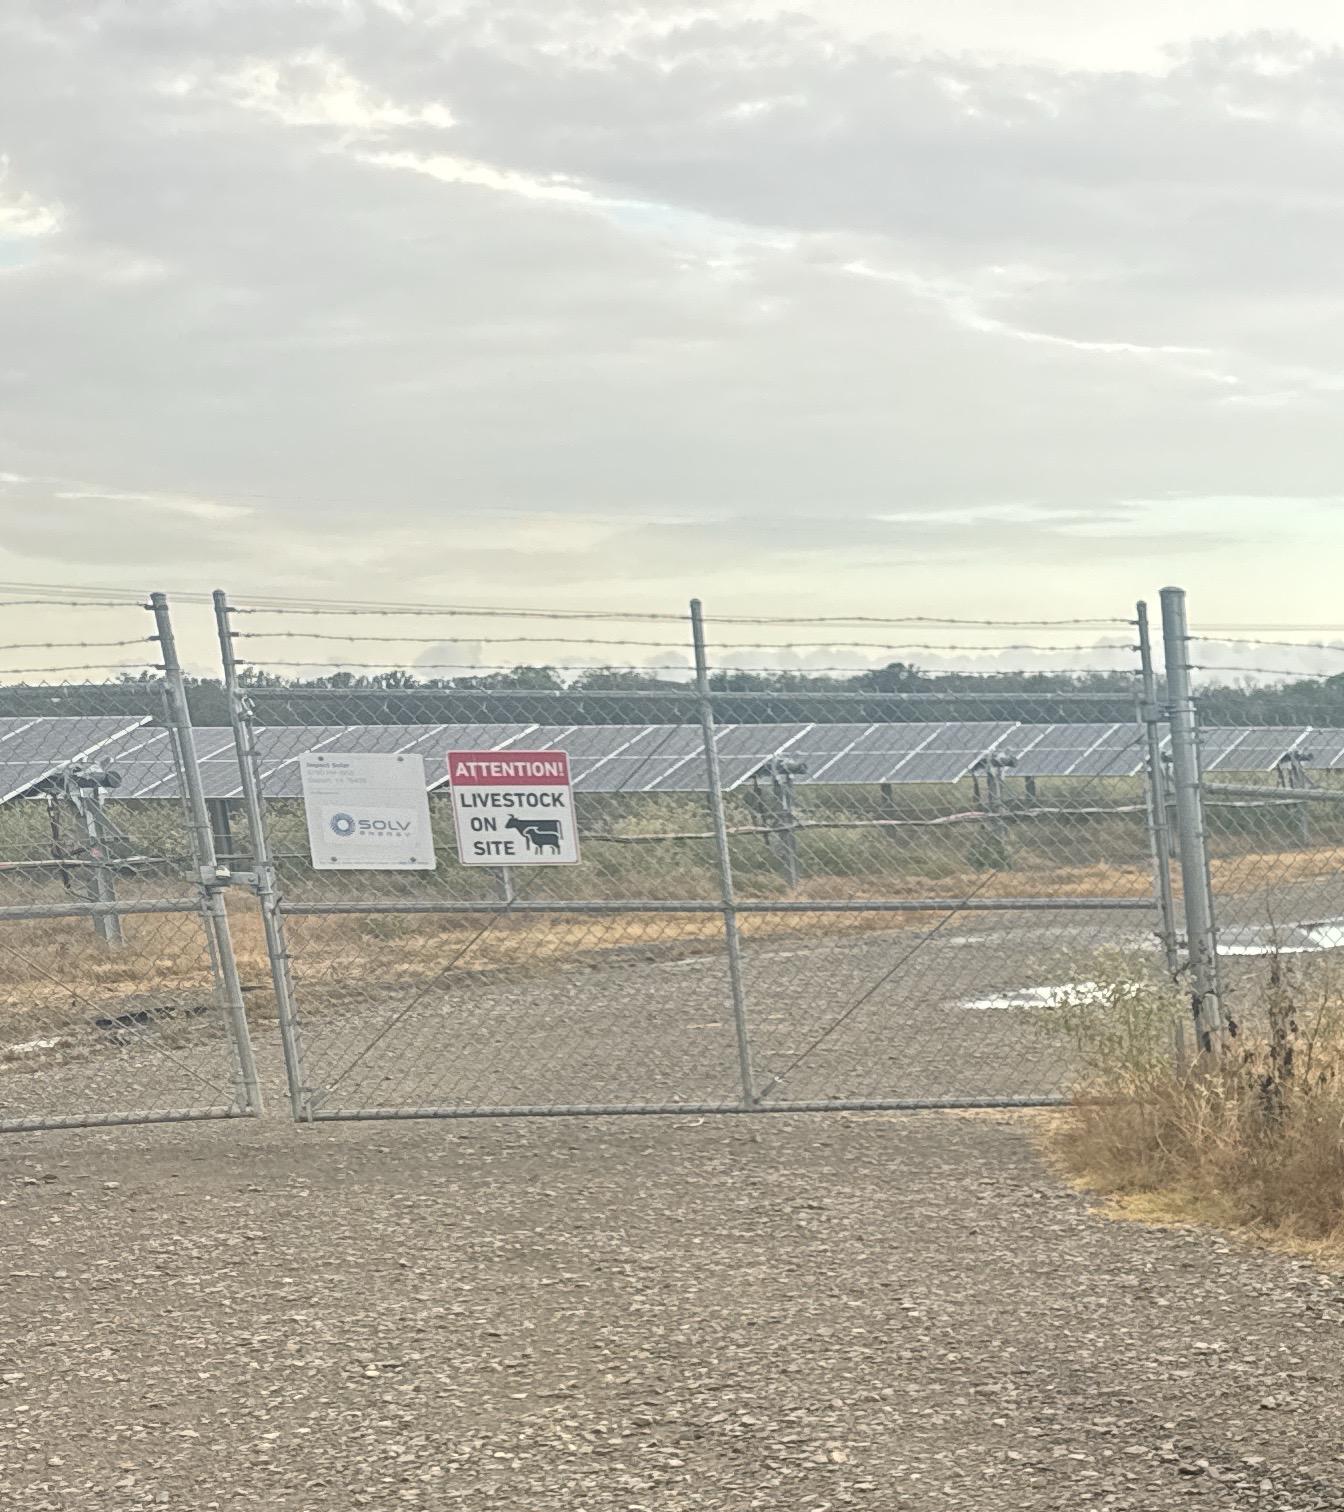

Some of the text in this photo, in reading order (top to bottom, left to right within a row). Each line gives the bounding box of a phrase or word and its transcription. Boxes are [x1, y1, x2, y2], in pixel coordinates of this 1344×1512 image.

[455, 761, 565, 777] ATTENTION!
[460, 793, 565, 808] LIVESTOCK
[358, 819, 411, 831] SOLV
[470, 817, 497, 832] ON
[473, 841, 515, 856] SITE
